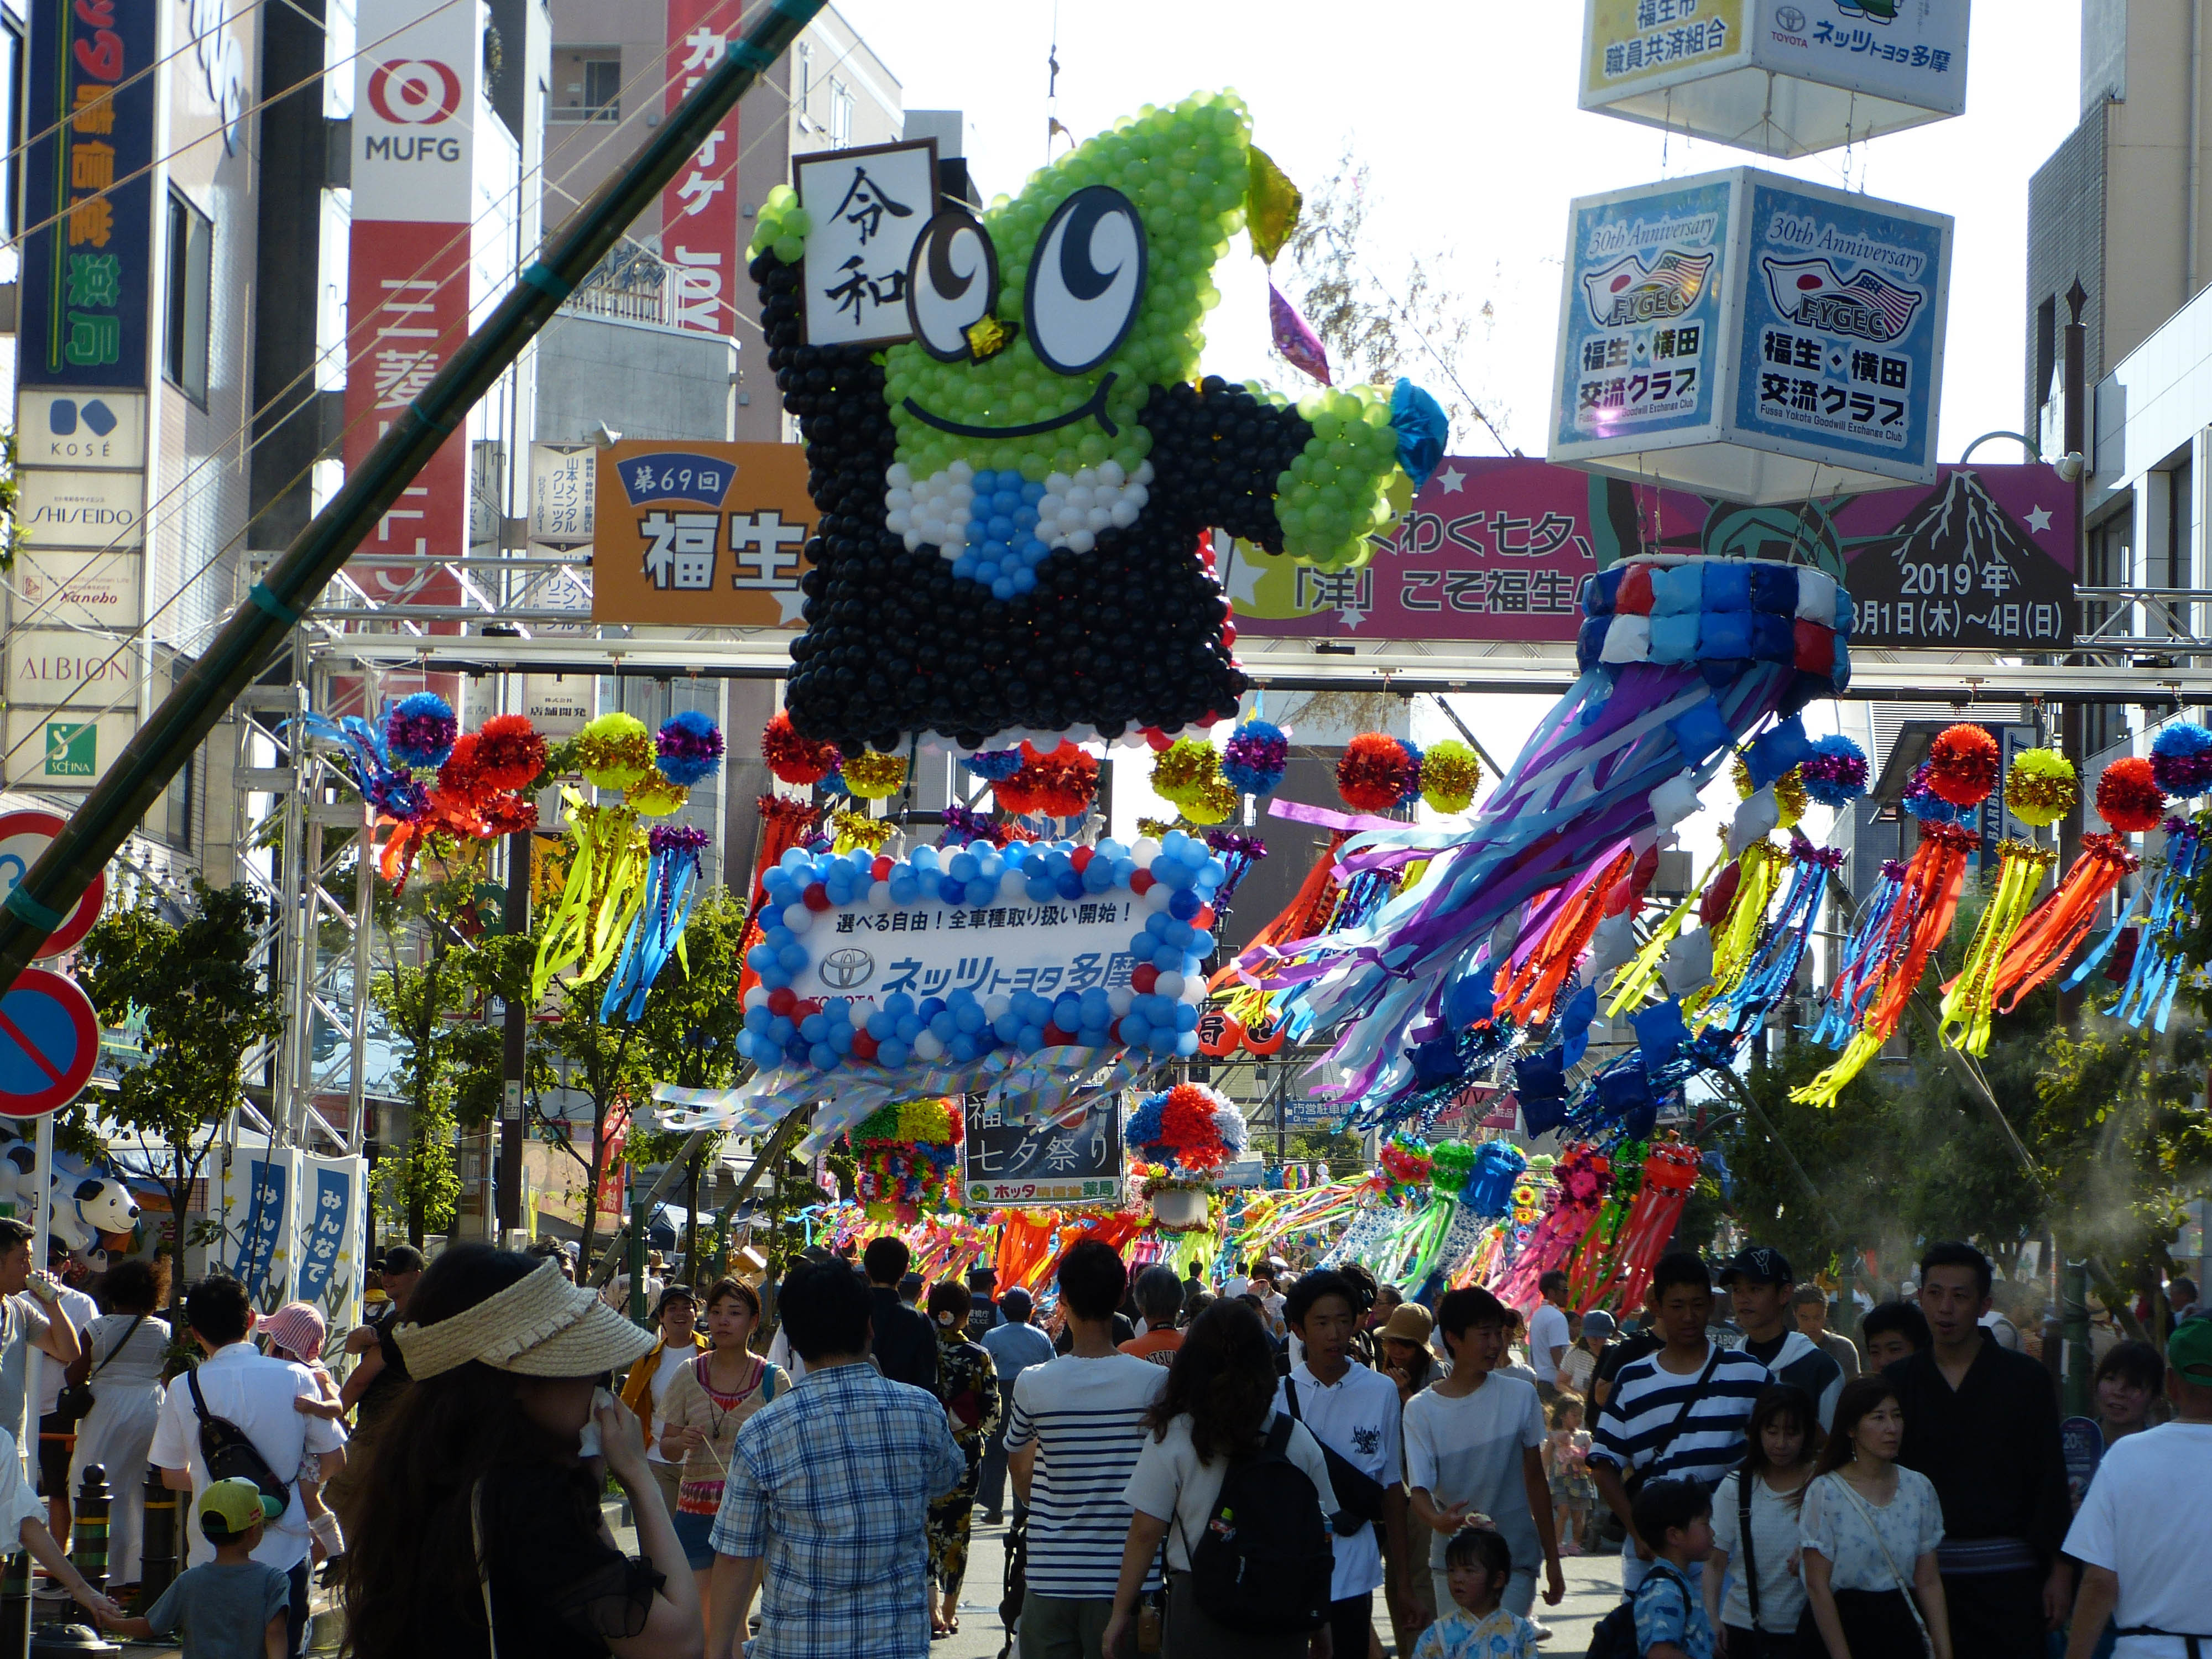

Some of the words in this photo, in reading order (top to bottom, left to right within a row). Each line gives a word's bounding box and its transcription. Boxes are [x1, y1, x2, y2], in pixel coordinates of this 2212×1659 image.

[1603, 18, 1727, 77] 職員共済組合
[1771, 31, 1808, 49] TOYOTA
[1813, 20, 1951, 74] ネッツトヨタ多摩
[366, 136, 460, 161] MUFG
[825, 166, 914, 325] 令和
[1589, 226, 1624, 254] 30th
[1628, 213, 1715, 247] Anniversary
[1771, 217, 1814, 247] 30th
[1820, 232, 1923, 276] Anniversary
[1609, 285, 1685, 326] FYGEC
[1797, 293, 1888, 341] FYGEC
[1765, 331, 1907, 389] 福生・横田
[1579, 368, 1697, 410] 交流クラブ
[1622, 404, 1648, 417] Goodwill
[1649, 401, 1678, 414] Exchange
[1680, 399, 1693, 409] Club
[1761, 373, 1904, 427] 交流クラブ
[1761, 404, 1782, 418] Fussa
[1786, 409, 1812, 424] Yokota
[1814, 415, 1846, 431] Goodwill
[1849, 422, 1883, 439] Exchange
[1886, 430, 1902, 442] Club
[51, 440, 110, 457] KOSÉ
[565, 458, 578, 533] 山本メンタル
[634, 465, 720, 494] 第69回
[28, 505, 133, 525] SHISEIDO
[552, 470, 564, 533] クリニック
[60, 590, 118, 604] Kanebo
[19, 657, 128, 681] ALBION
[969, 1136, 1107, 1173] 七夕祭り
[242, 1183, 278, 1282] みんなで
[308, 1189, 342, 1283] みんなで
